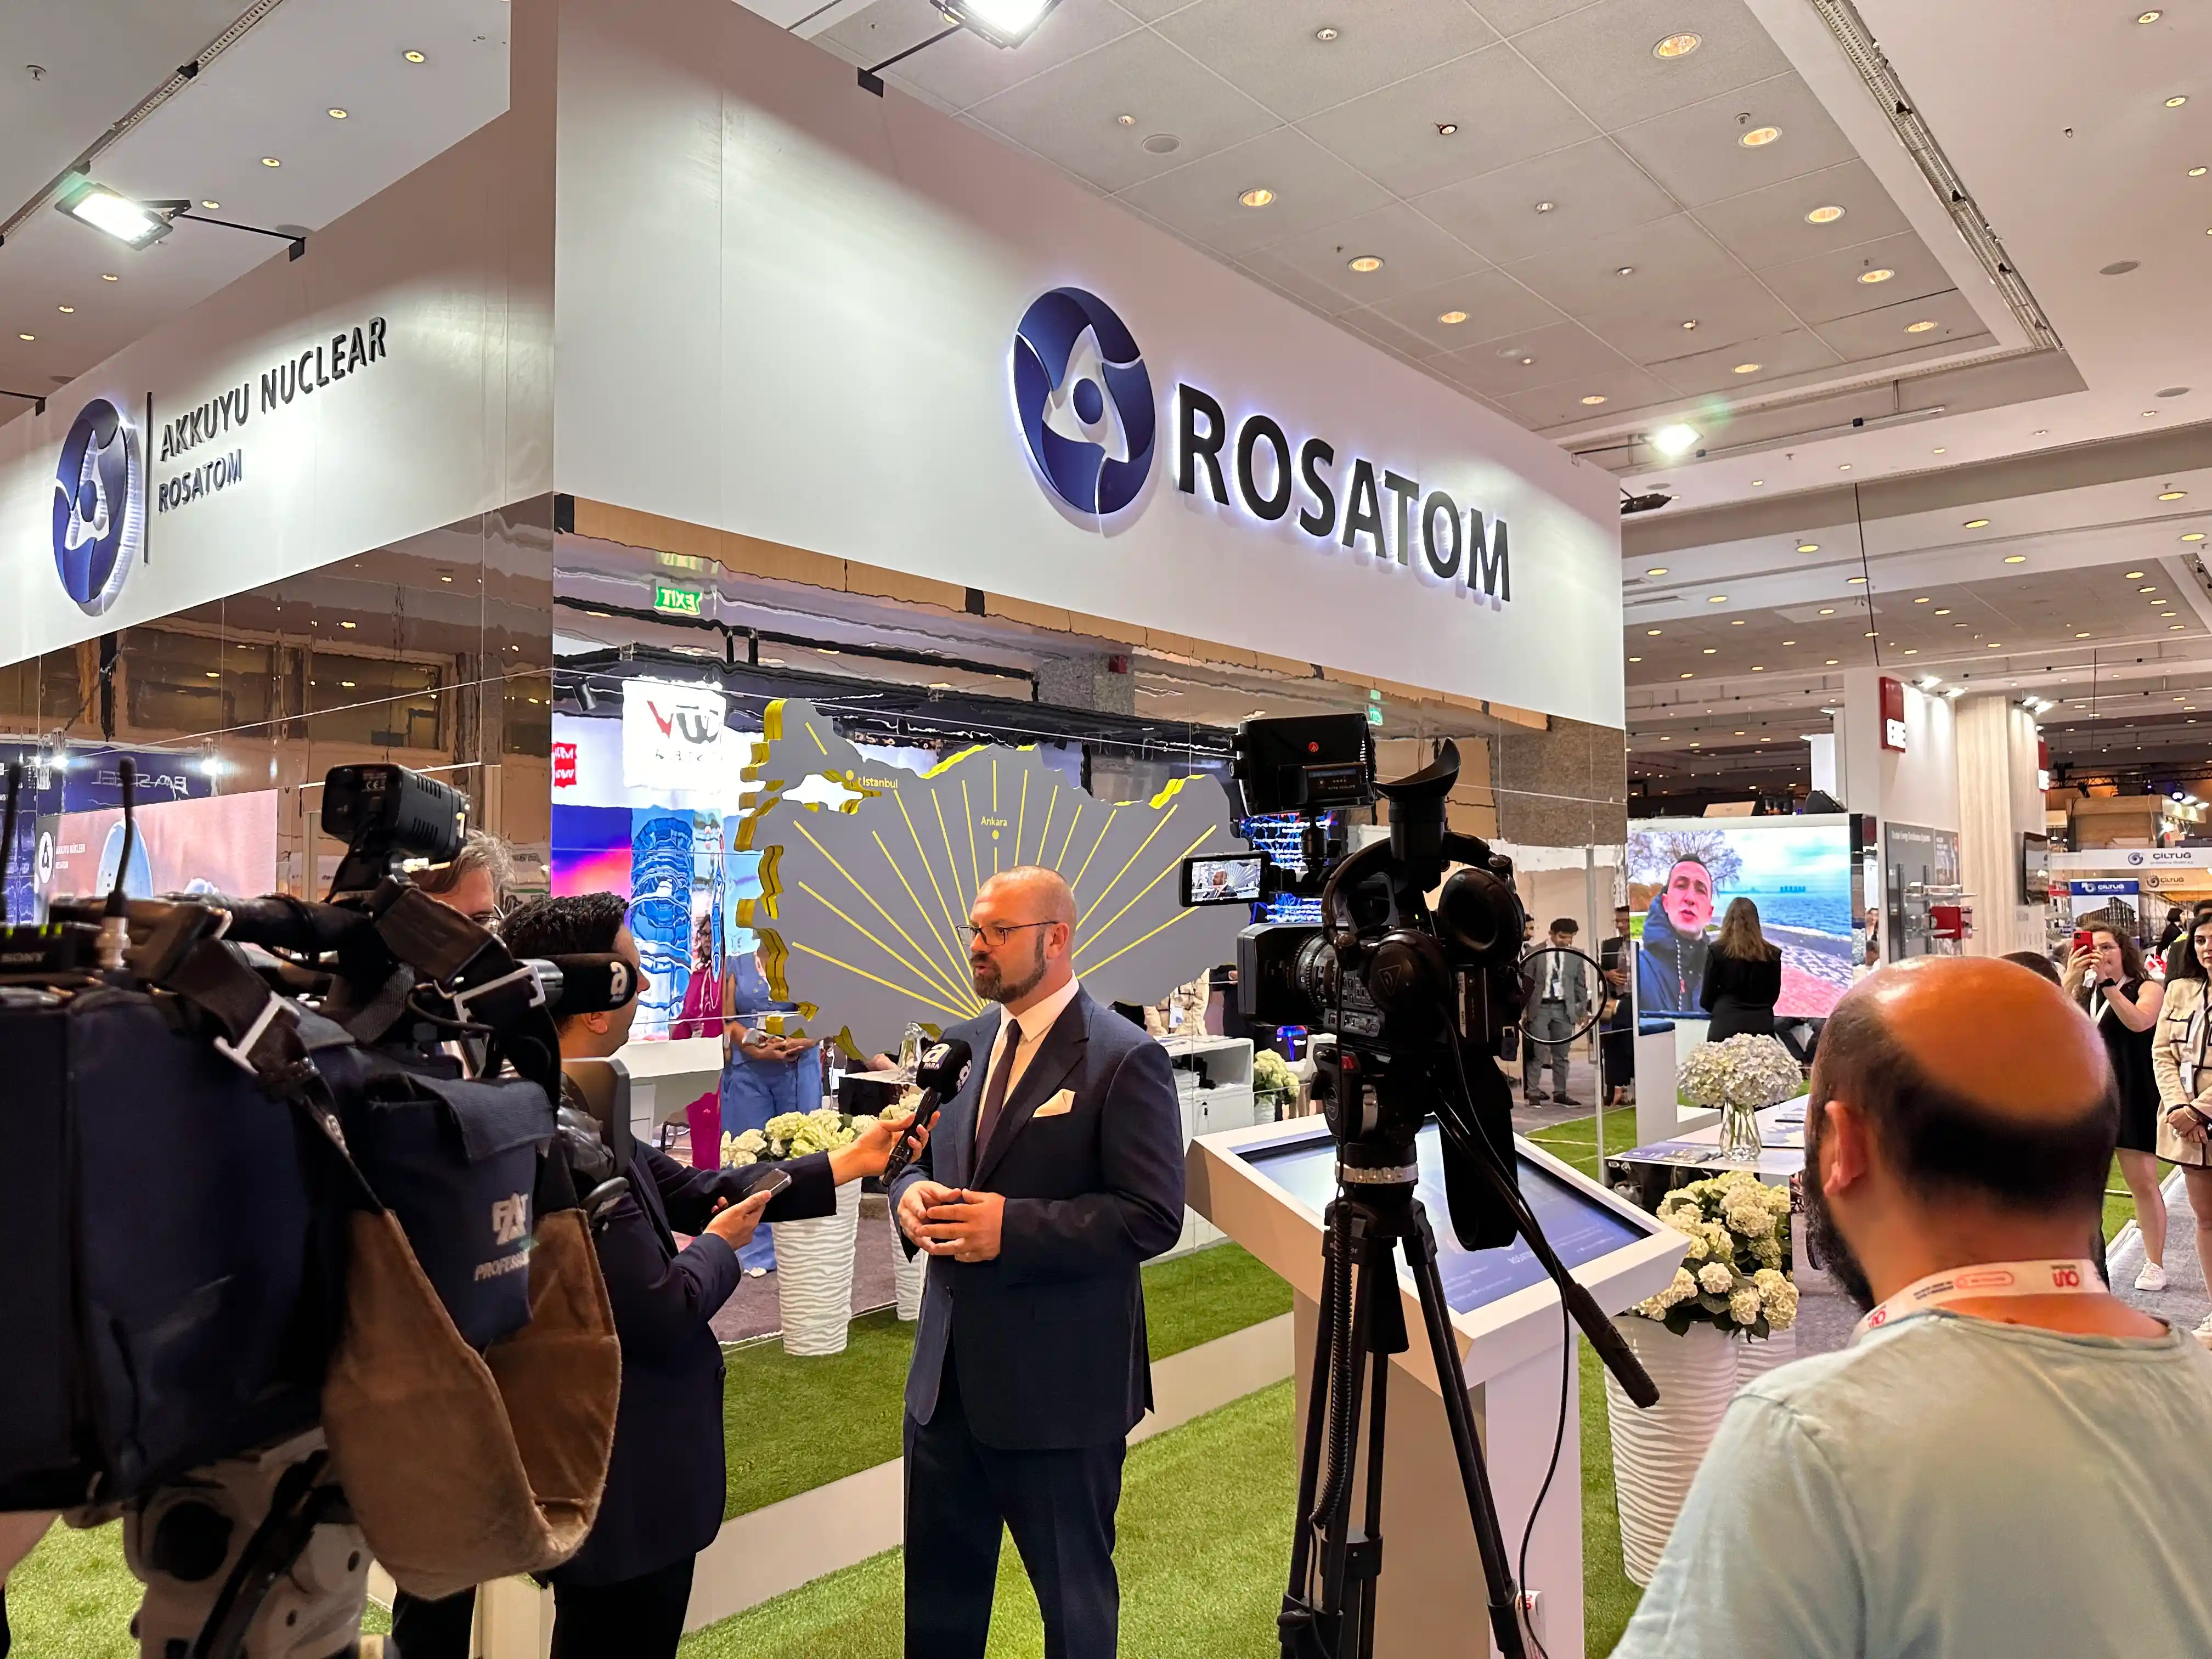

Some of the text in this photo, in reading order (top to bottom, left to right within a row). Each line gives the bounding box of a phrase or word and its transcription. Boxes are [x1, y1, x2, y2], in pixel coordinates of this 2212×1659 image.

[160, 316, 387, 462] AKKUYU NUCLEAR
[159, 448, 243, 515] ROSATOM
[1178, 382, 1511, 602] ROSATOM
[981, 816, 1007, 827] Ankara
